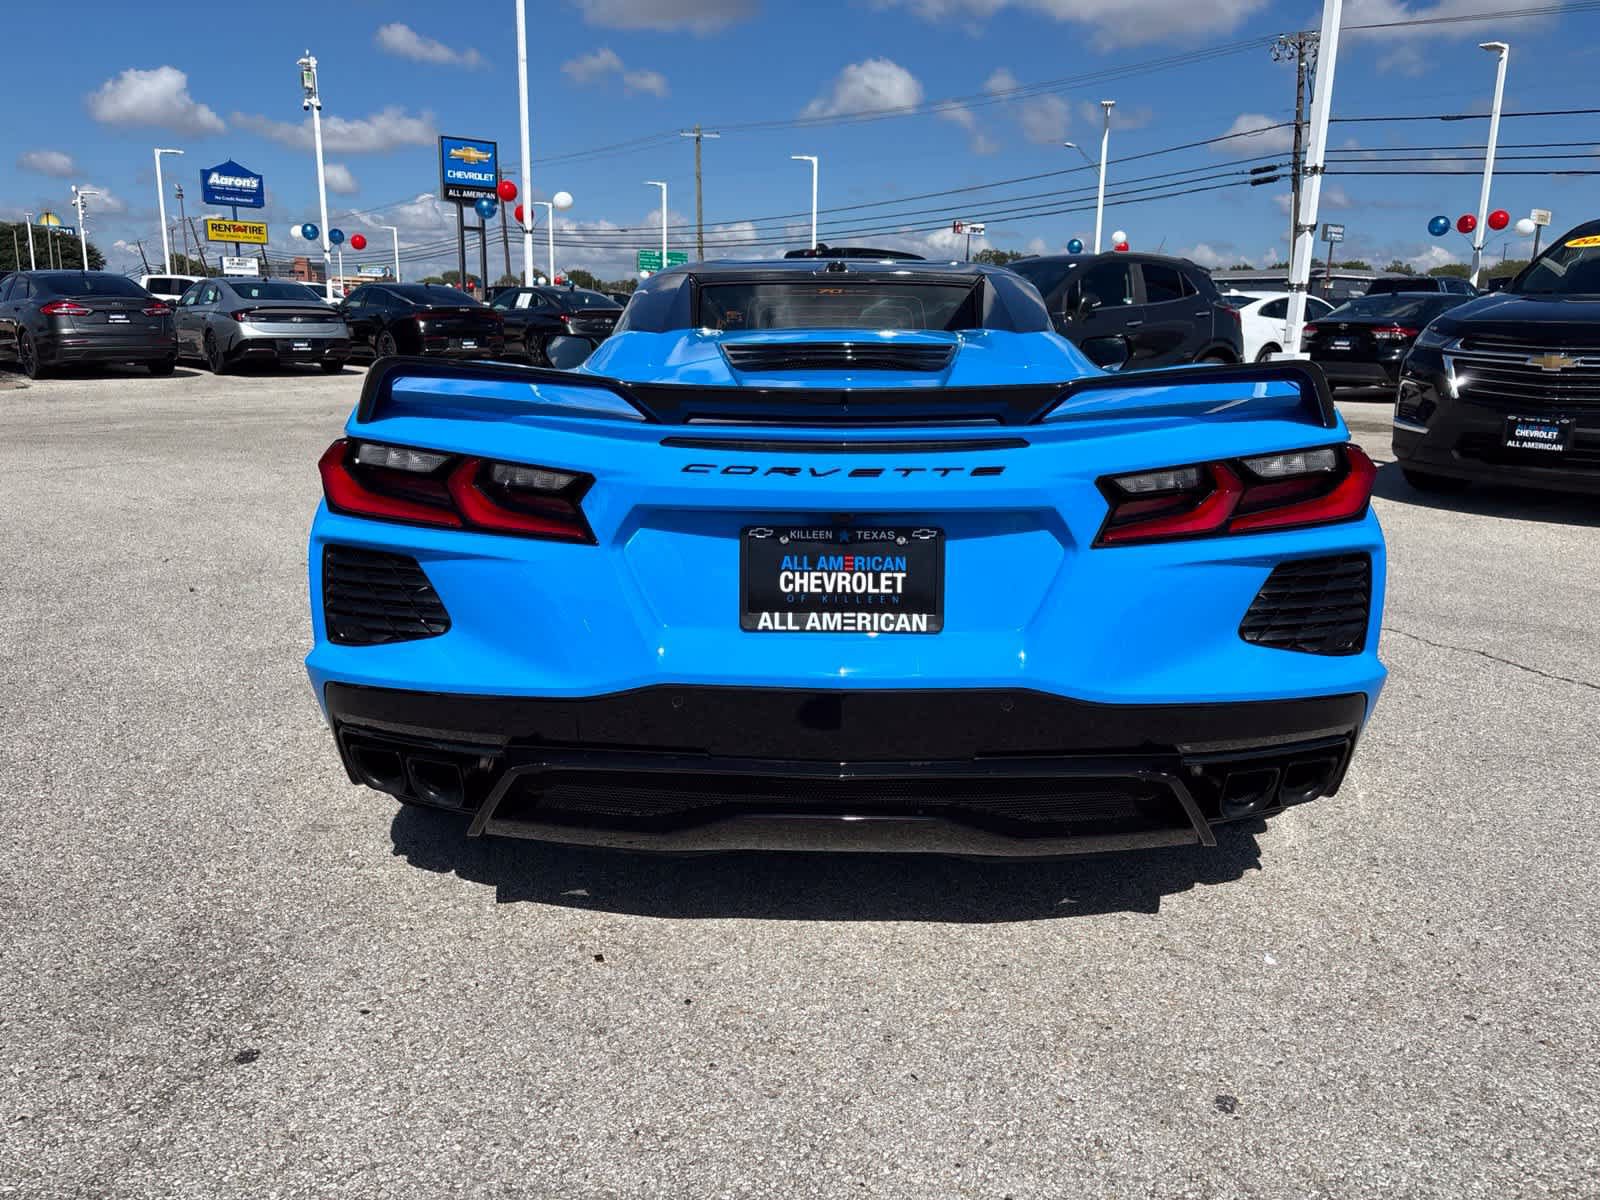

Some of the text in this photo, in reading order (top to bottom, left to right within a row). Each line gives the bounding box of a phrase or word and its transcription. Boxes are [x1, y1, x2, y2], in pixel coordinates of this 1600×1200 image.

[209, 172, 259, 189] Aaron's
[447, 170, 495, 181] CHEVROLET
[448, 189, 496, 199] ALL AMERICAN
[1515, 428, 1558, 439] CHEVROLET
[1506, 440, 1563, 451] ALL AMERICAN
[681, 463, 1006, 478] CORVETTE
[789, 530, 895, 540] KILLEEN TEXAS
[781, 556, 907, 571] ALL AMERICAN
[779, 571, 906, 593] CHEVROLET
[786, 594, 900, 604] OF KILLEEN
[757, 612, 928, 632] ALL AMERICAN
